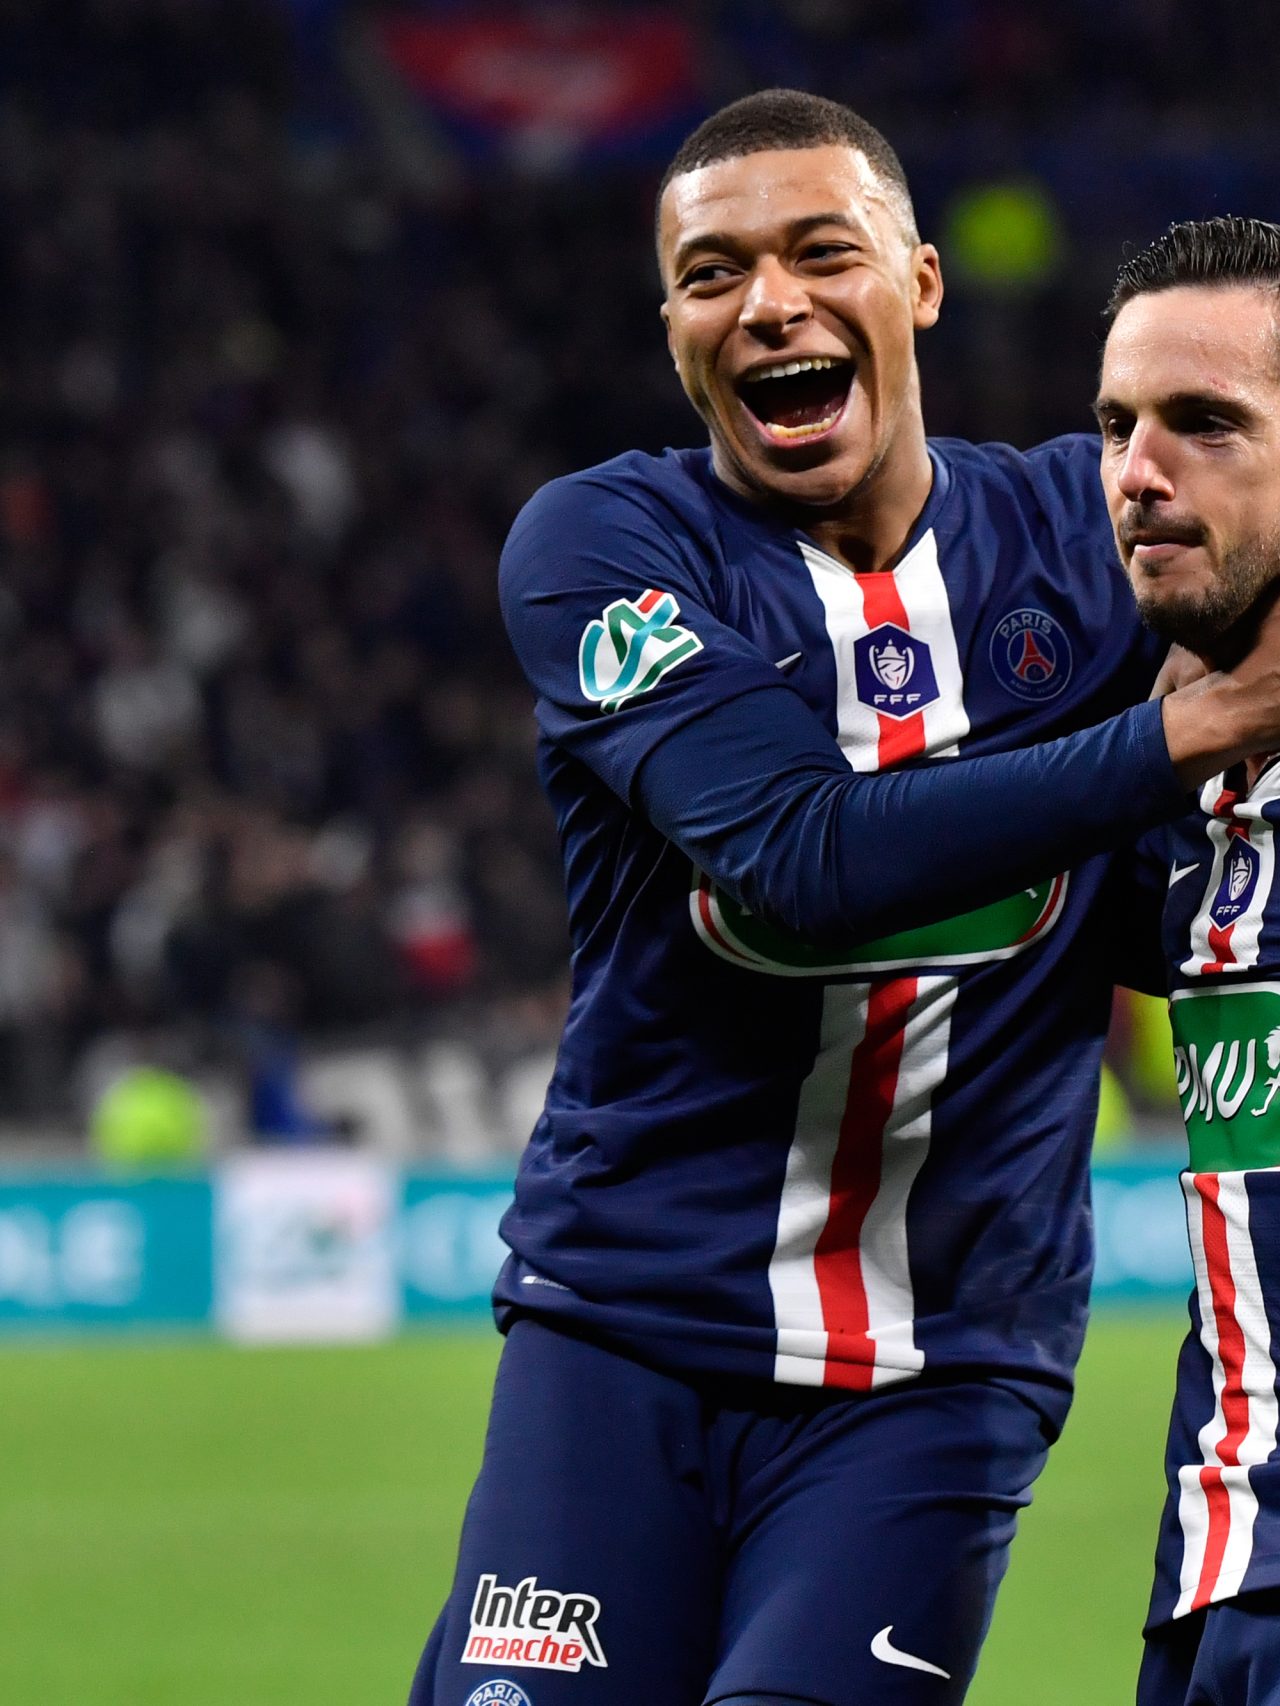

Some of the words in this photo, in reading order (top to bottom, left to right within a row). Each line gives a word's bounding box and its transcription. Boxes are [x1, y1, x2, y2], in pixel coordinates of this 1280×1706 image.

[999, 613, 1054, 639] PARIS
[873, 693, 921, 706] FFF
[1216, 905, 1241, 917] FFF
[473, 1685, 522, 1706] PARIS
